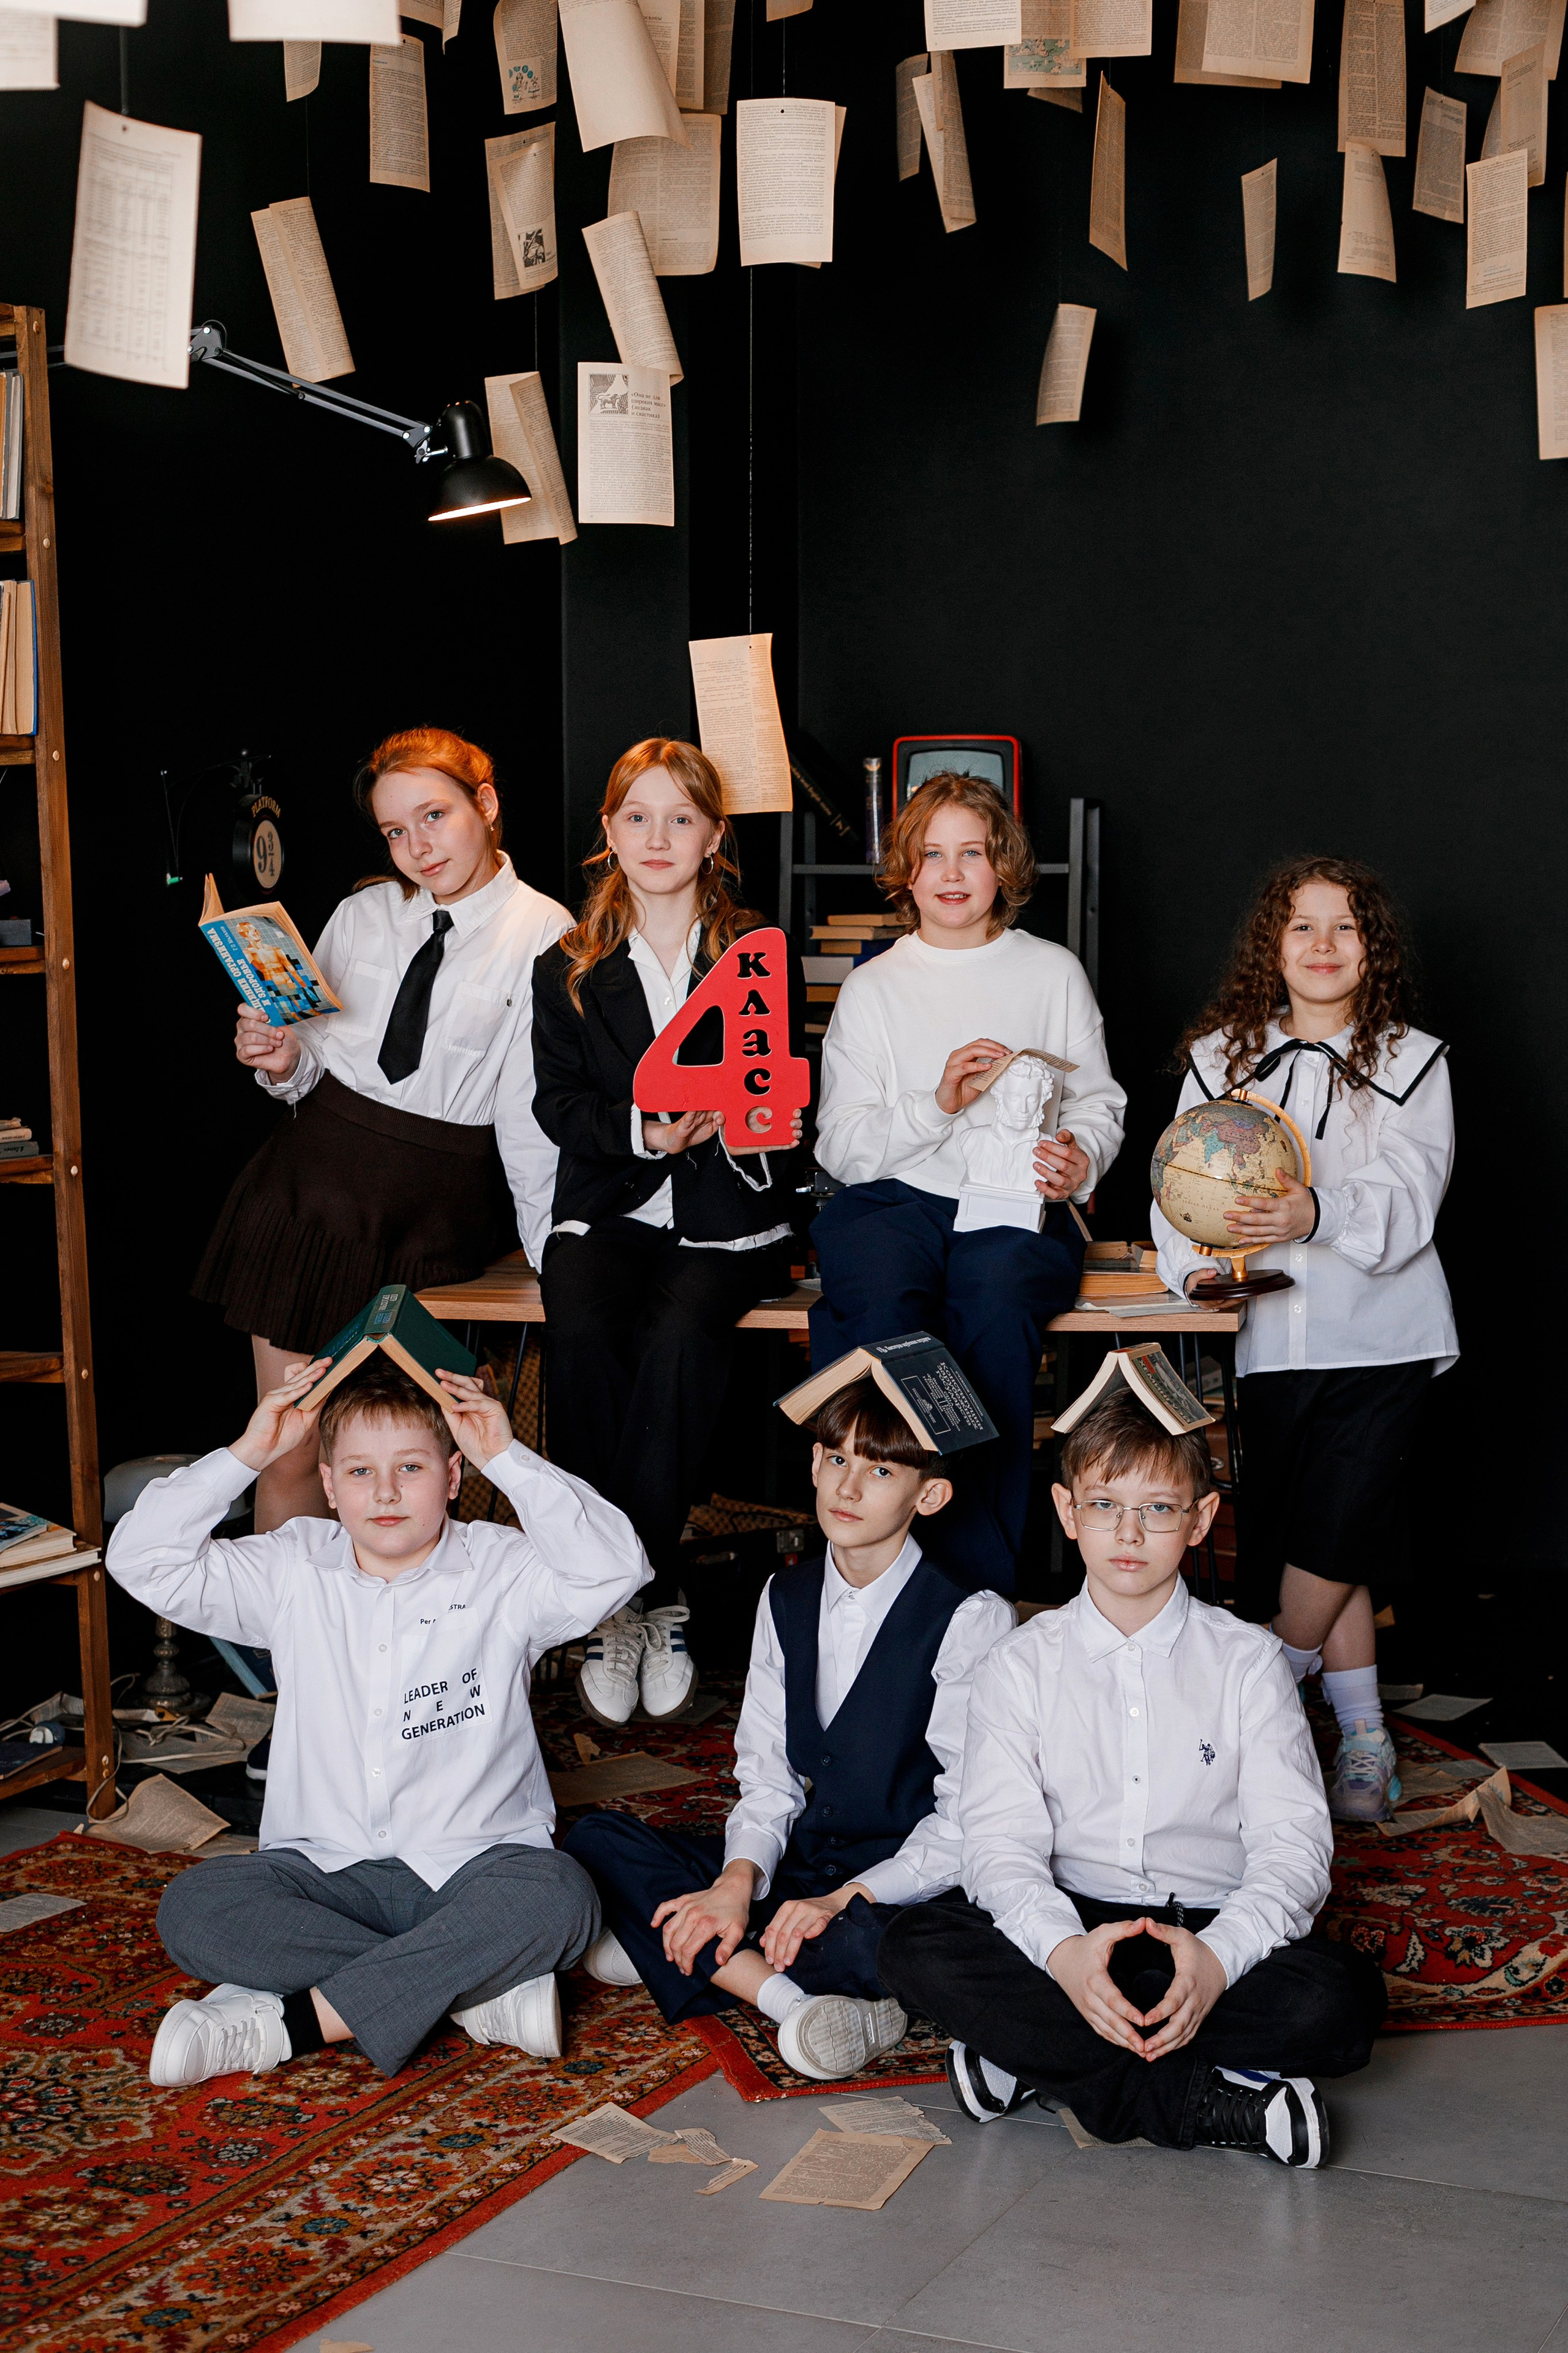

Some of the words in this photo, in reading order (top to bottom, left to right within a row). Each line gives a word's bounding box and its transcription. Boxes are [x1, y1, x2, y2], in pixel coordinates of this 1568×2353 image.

[251, 796, 281, 818] PLATFORM
[207, 927, 241, 977] ОРГАНИЗМА
[236, 958, 266, 999] ЗДОРОВЬЕ
[633, 927, 810, 1147] 4
[404, 1681, 448, 1704] LEADER
[462, 1667, 478, 1685] OF
[402, 1704, 486, 1740] GENERATION
